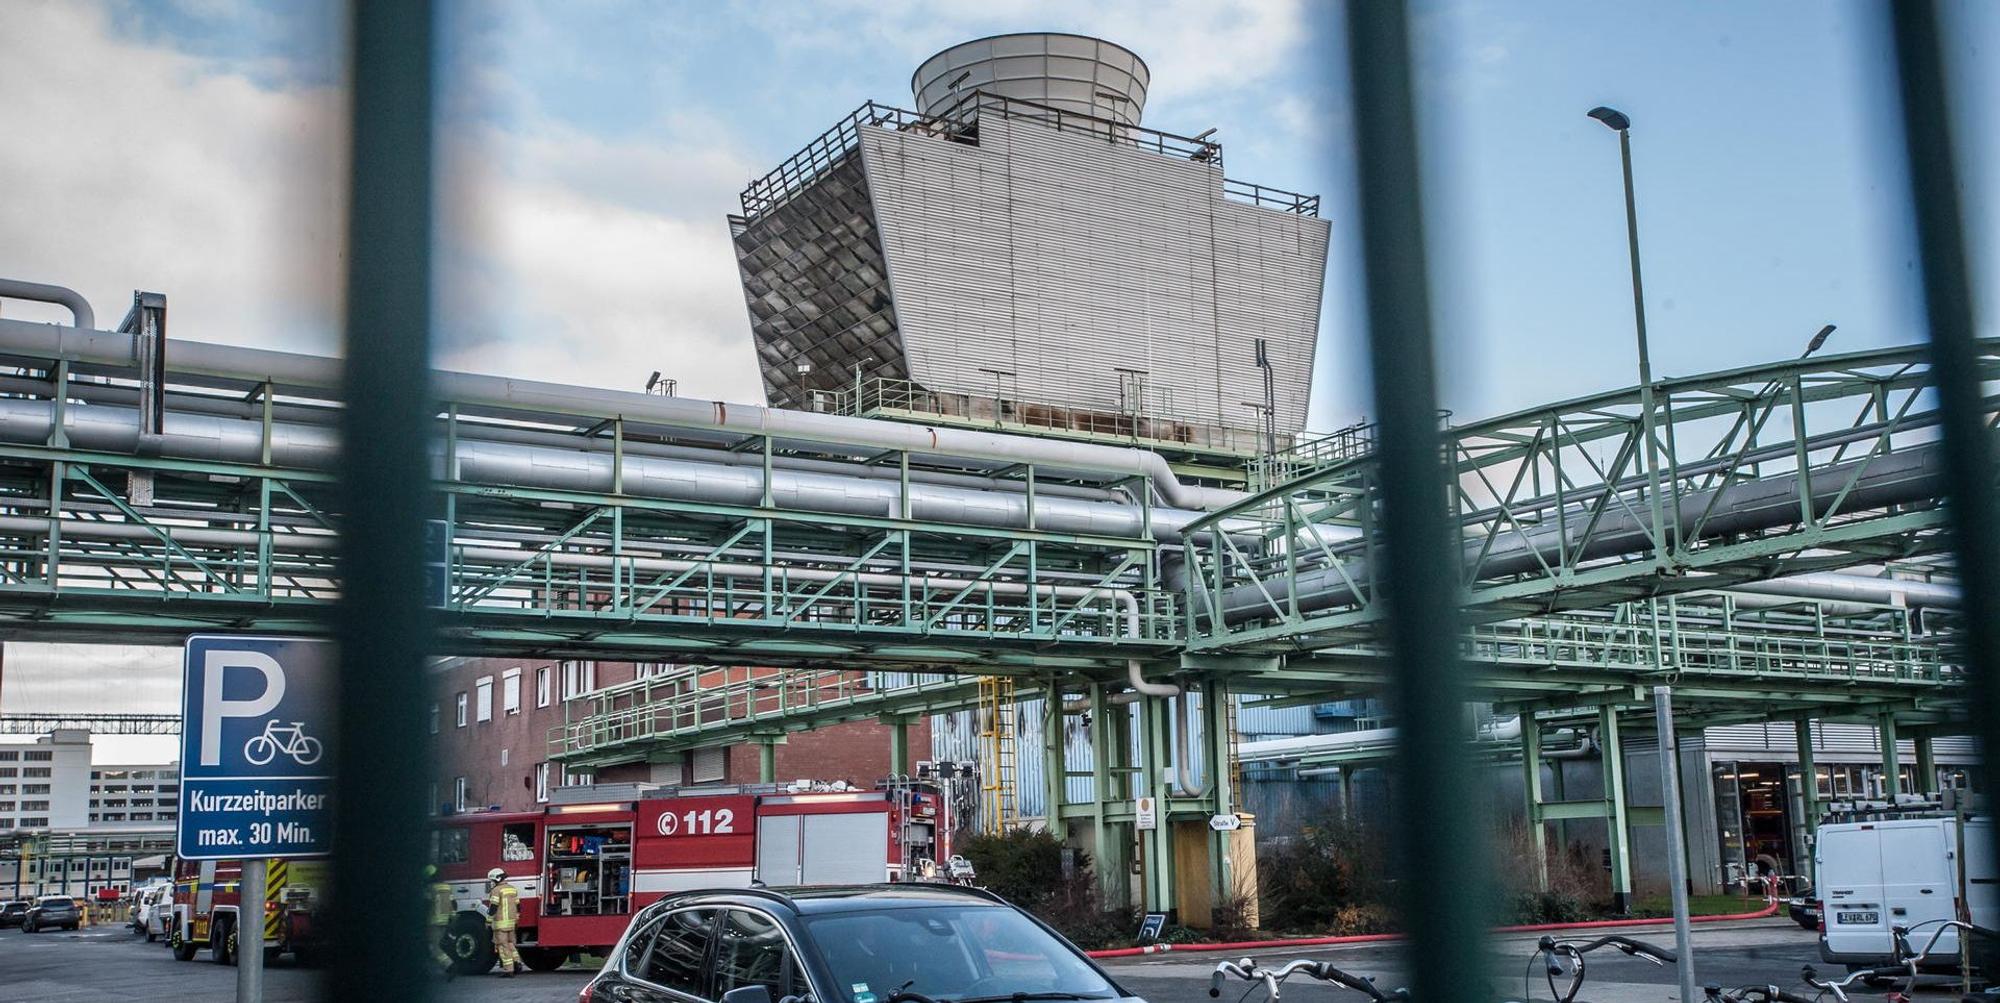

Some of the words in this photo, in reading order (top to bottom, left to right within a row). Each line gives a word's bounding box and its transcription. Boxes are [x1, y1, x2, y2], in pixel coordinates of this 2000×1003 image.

[200, 649, 286, 766] P
[190, 788, 326, 816] Kurzzeitparker
[198, 828, 243, 846] max.
[249, 822, 271, 845] 30
[277, 822, 316, 844] Min.
[683, 808, 734, 835] 112
